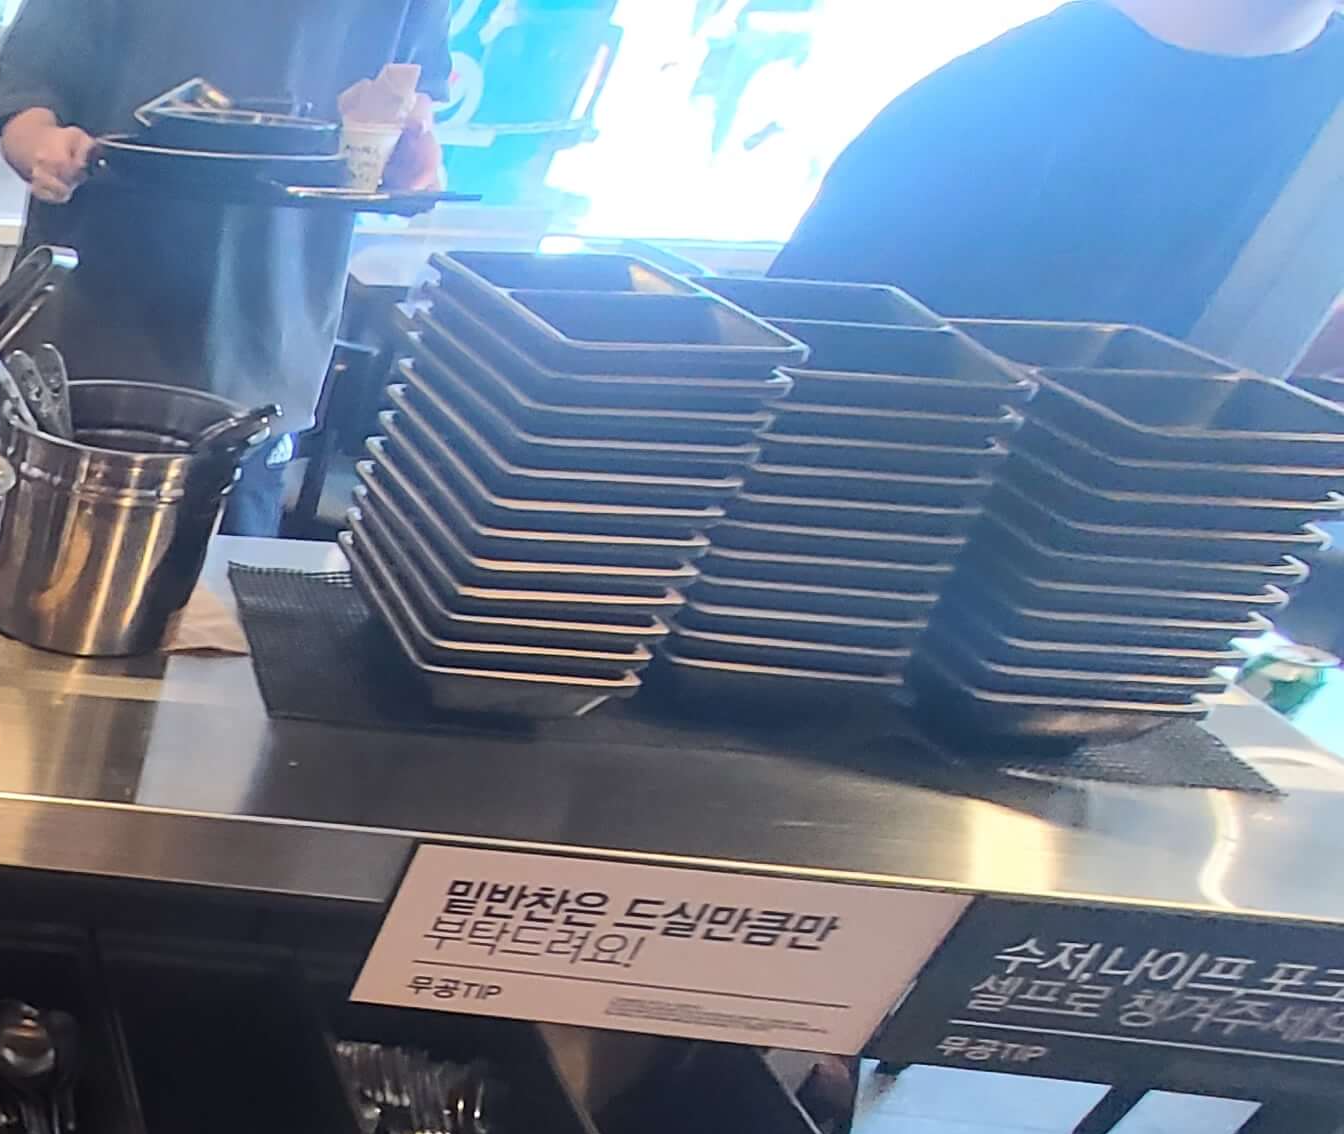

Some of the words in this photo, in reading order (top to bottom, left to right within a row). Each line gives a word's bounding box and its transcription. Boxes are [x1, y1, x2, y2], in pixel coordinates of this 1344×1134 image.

[441, 879, 610, 928] 밑반찬은
[612, 897, 841, 952] 드실만큼만
[423, 916, 646, 967] 부탁드려요!
[407, 975, 502, 1000] 무공TIP
[967, 975, 1116, 1018] 셀프로
[937, 1035, 1048, 1062] 무공TIP
